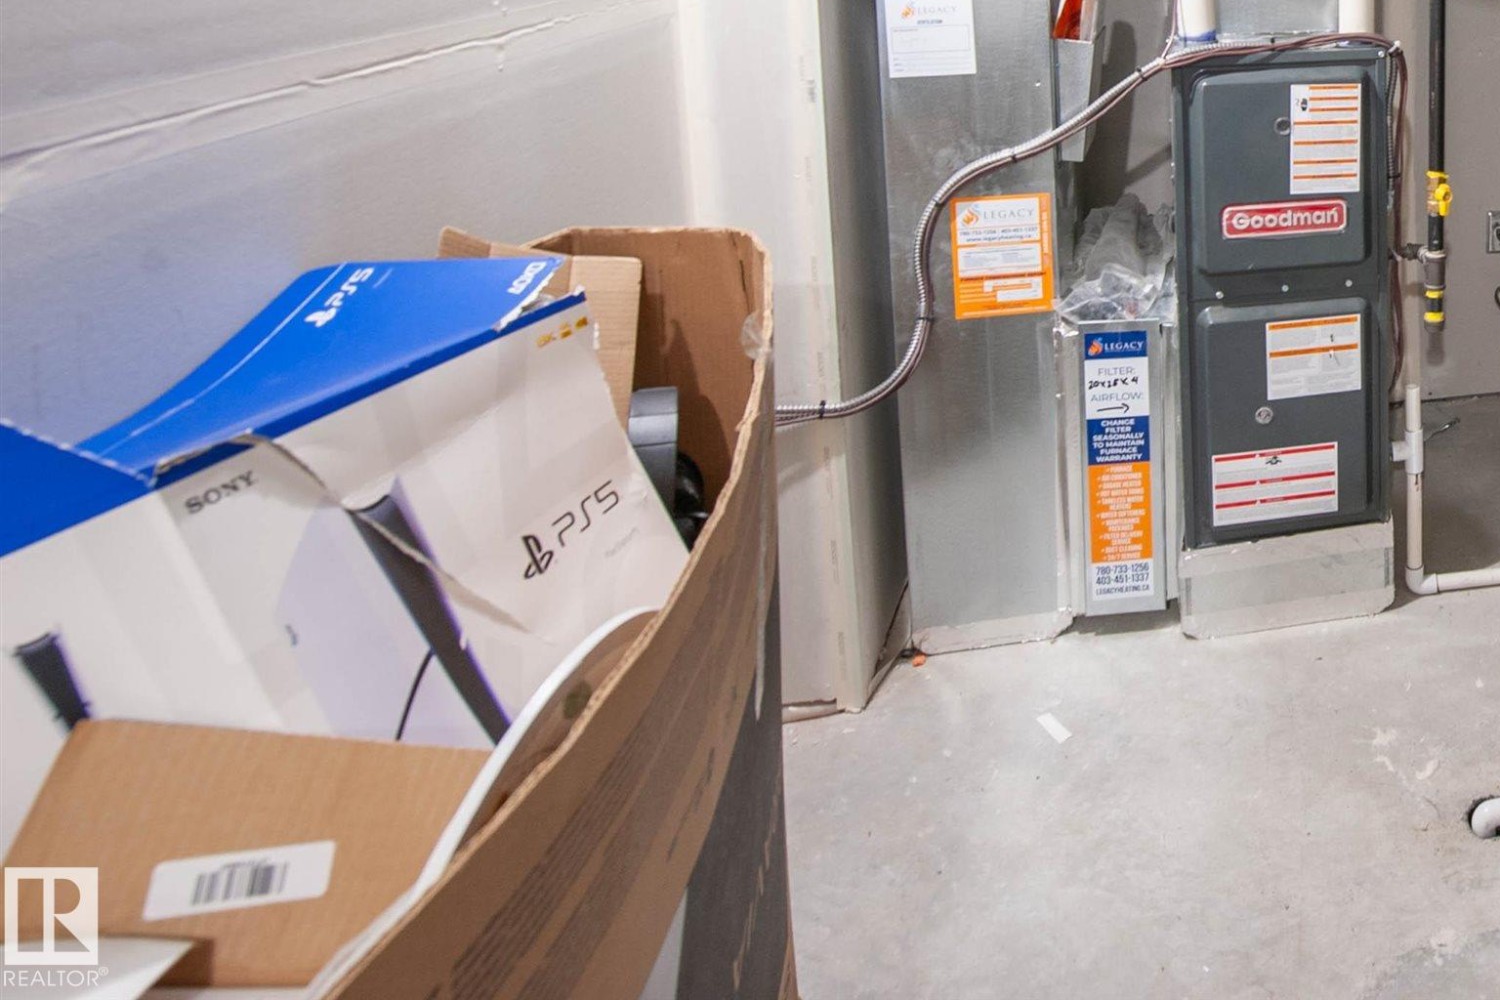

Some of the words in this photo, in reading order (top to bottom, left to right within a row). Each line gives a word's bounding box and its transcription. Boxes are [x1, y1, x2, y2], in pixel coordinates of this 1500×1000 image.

[983, 208, 1035, 220] LEGACY
[1231, 207, 1339, 230] Goodman
[1104, 340, 1144, 351] LEGACY
[1100, 418, 1135, 427] CHANGE
[1105, 425, 1132, 434] FILTER
[1093, 441, 1104, 449] TO
[185, 470, 253, 514] SONY
[551, 479, 619, 548] PS5
